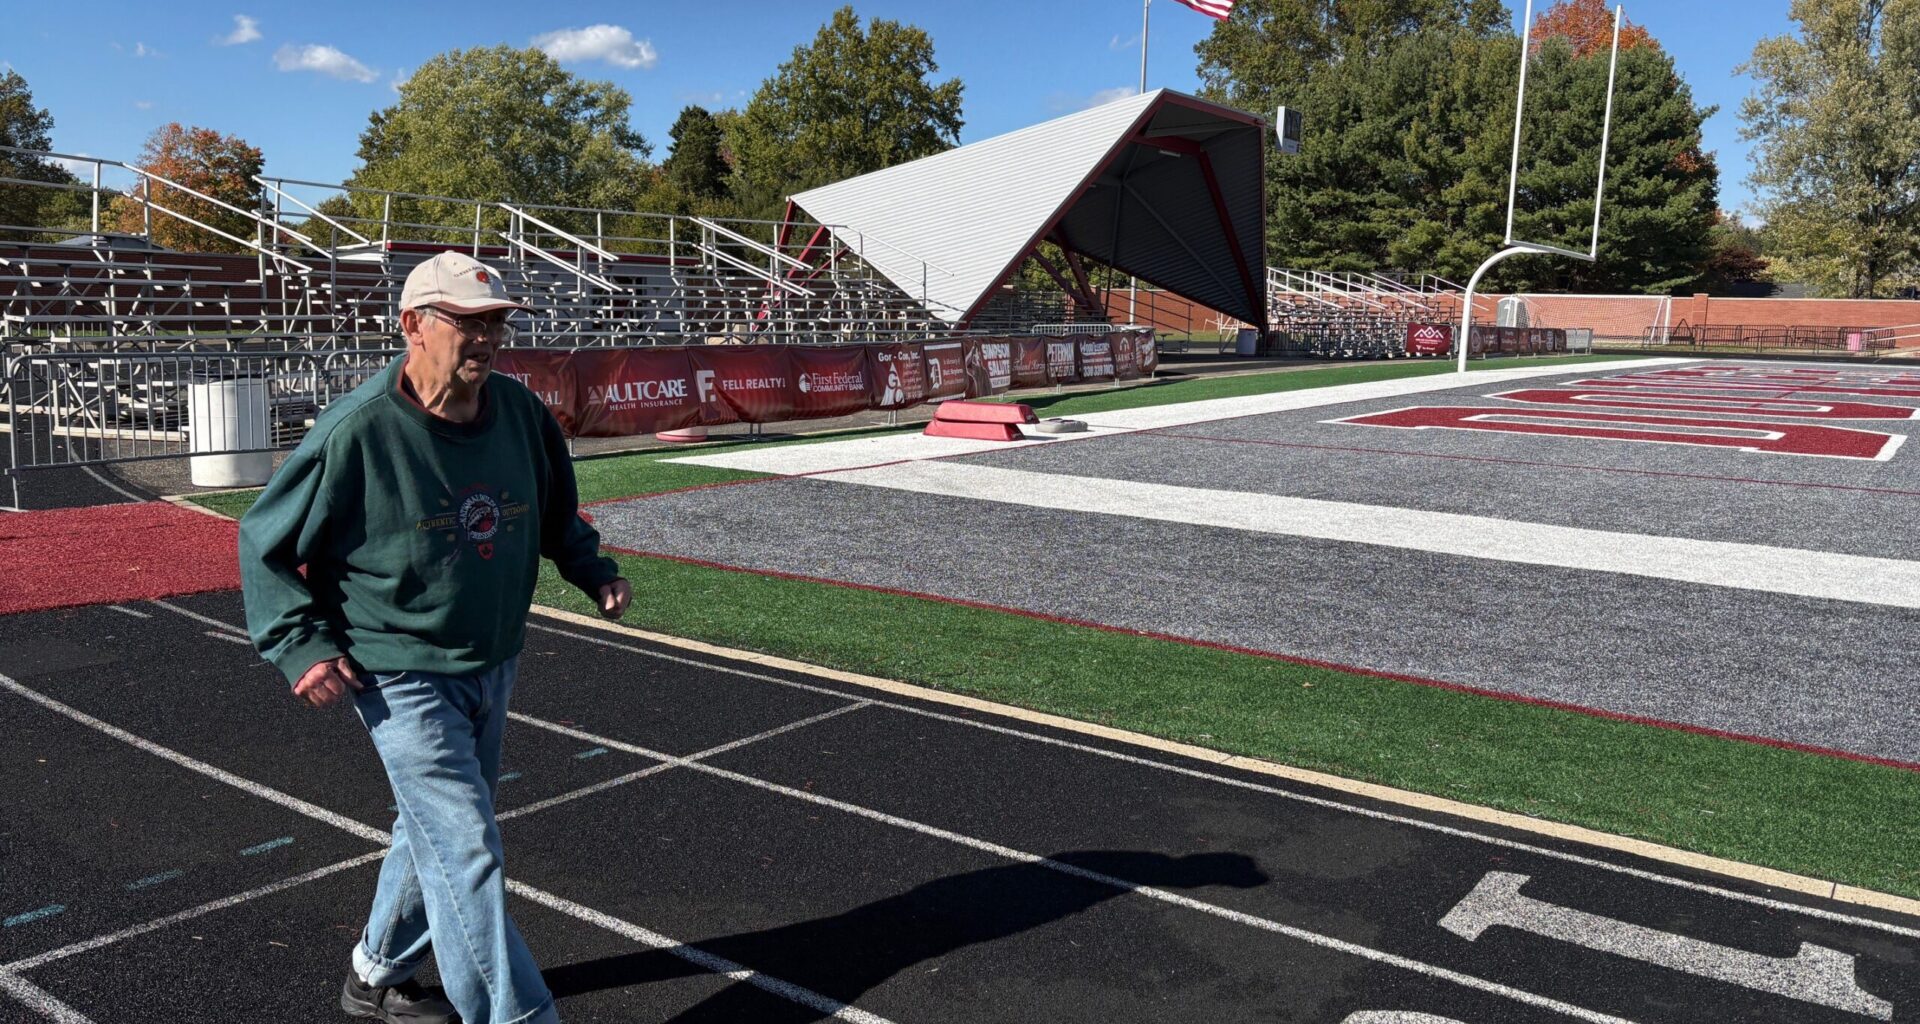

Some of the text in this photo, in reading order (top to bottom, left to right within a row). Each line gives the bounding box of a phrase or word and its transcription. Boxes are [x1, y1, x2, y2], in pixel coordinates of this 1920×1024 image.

[878, 352, 892, 362] Gor
[981, 343, 1010, 360] SIMPSON
[987, 359, 1010, 377] SALUTE
[812, 371, 863, 385] First Federal
[603, 378, 688, 404] AULTCARE
[722, 379, 745, 391] FELL
[812, 383, 865, 392] COMMUNITY BANK
[609, 398, 683, 411] HEALTH INSURANCE
